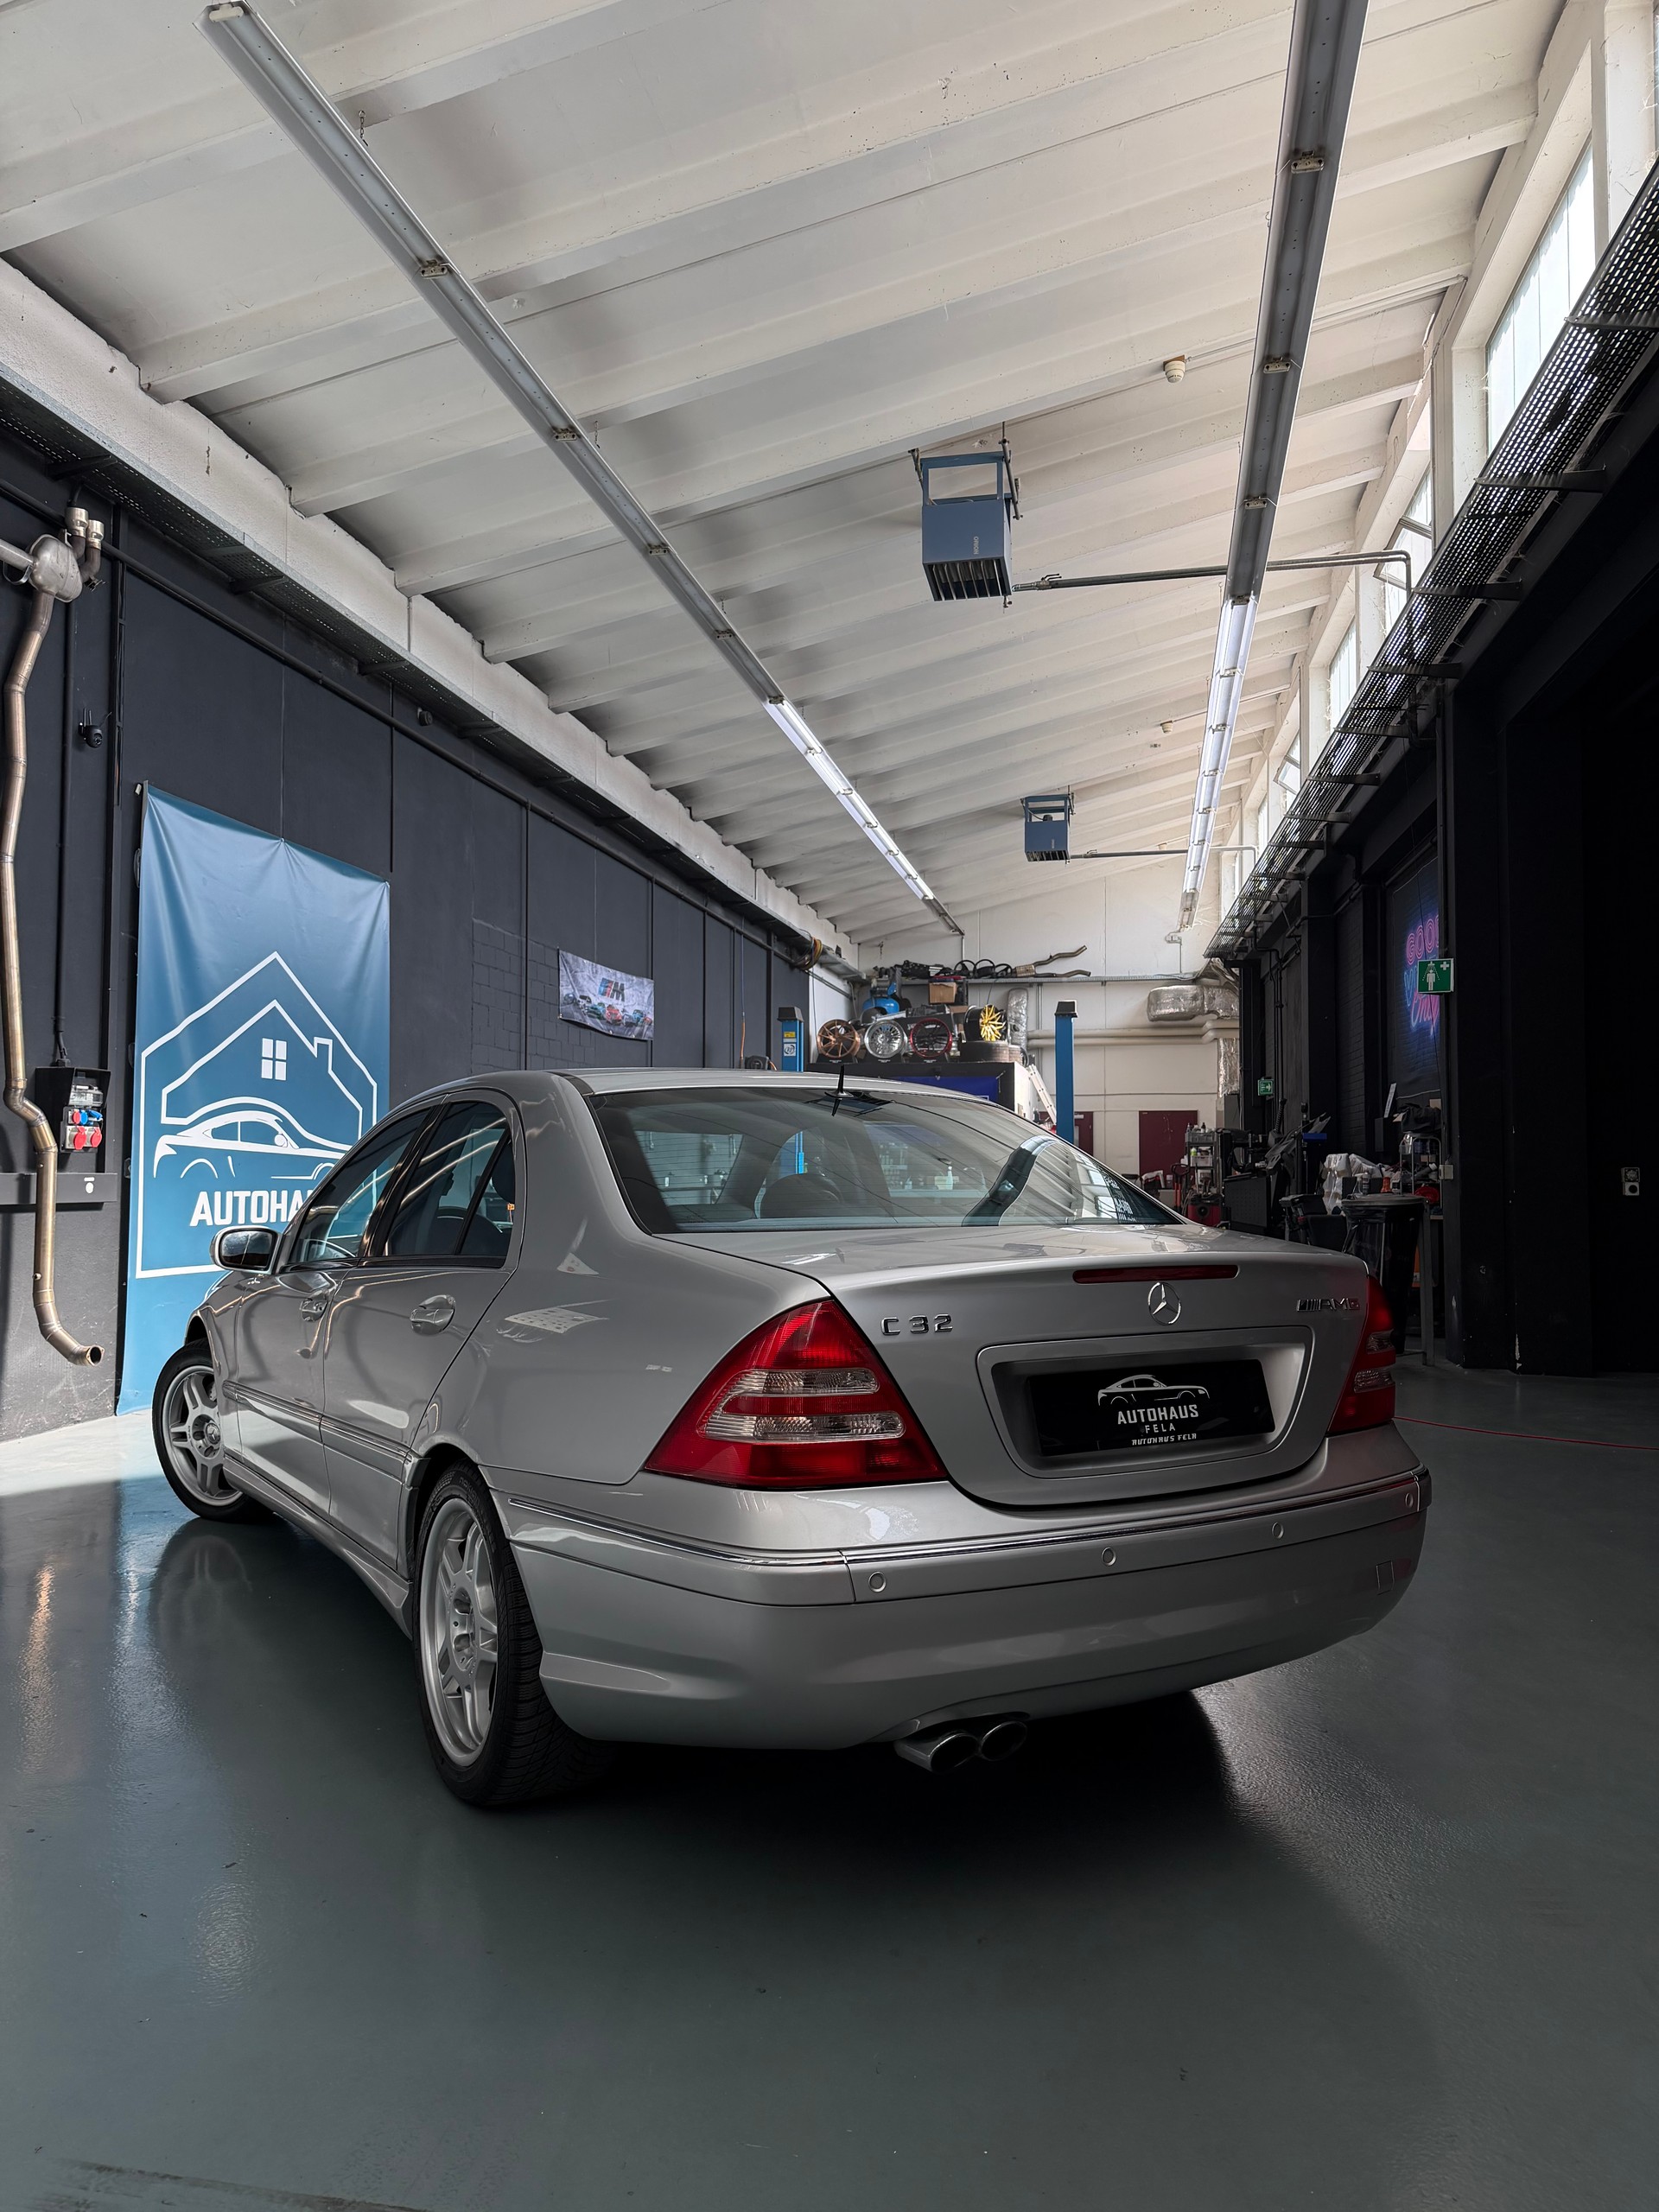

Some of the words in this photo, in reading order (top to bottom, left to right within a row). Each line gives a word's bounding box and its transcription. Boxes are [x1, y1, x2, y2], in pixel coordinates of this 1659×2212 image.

[189, 1189, 313, 1227] AUTOHA
[880, 1317, 901, 1336] C
[909, 1313, 953, 1333] 32
[1117, 1404, 1199, 1425] AUTOHAUS
[1144, 1422, 1176, 1434] FELA
